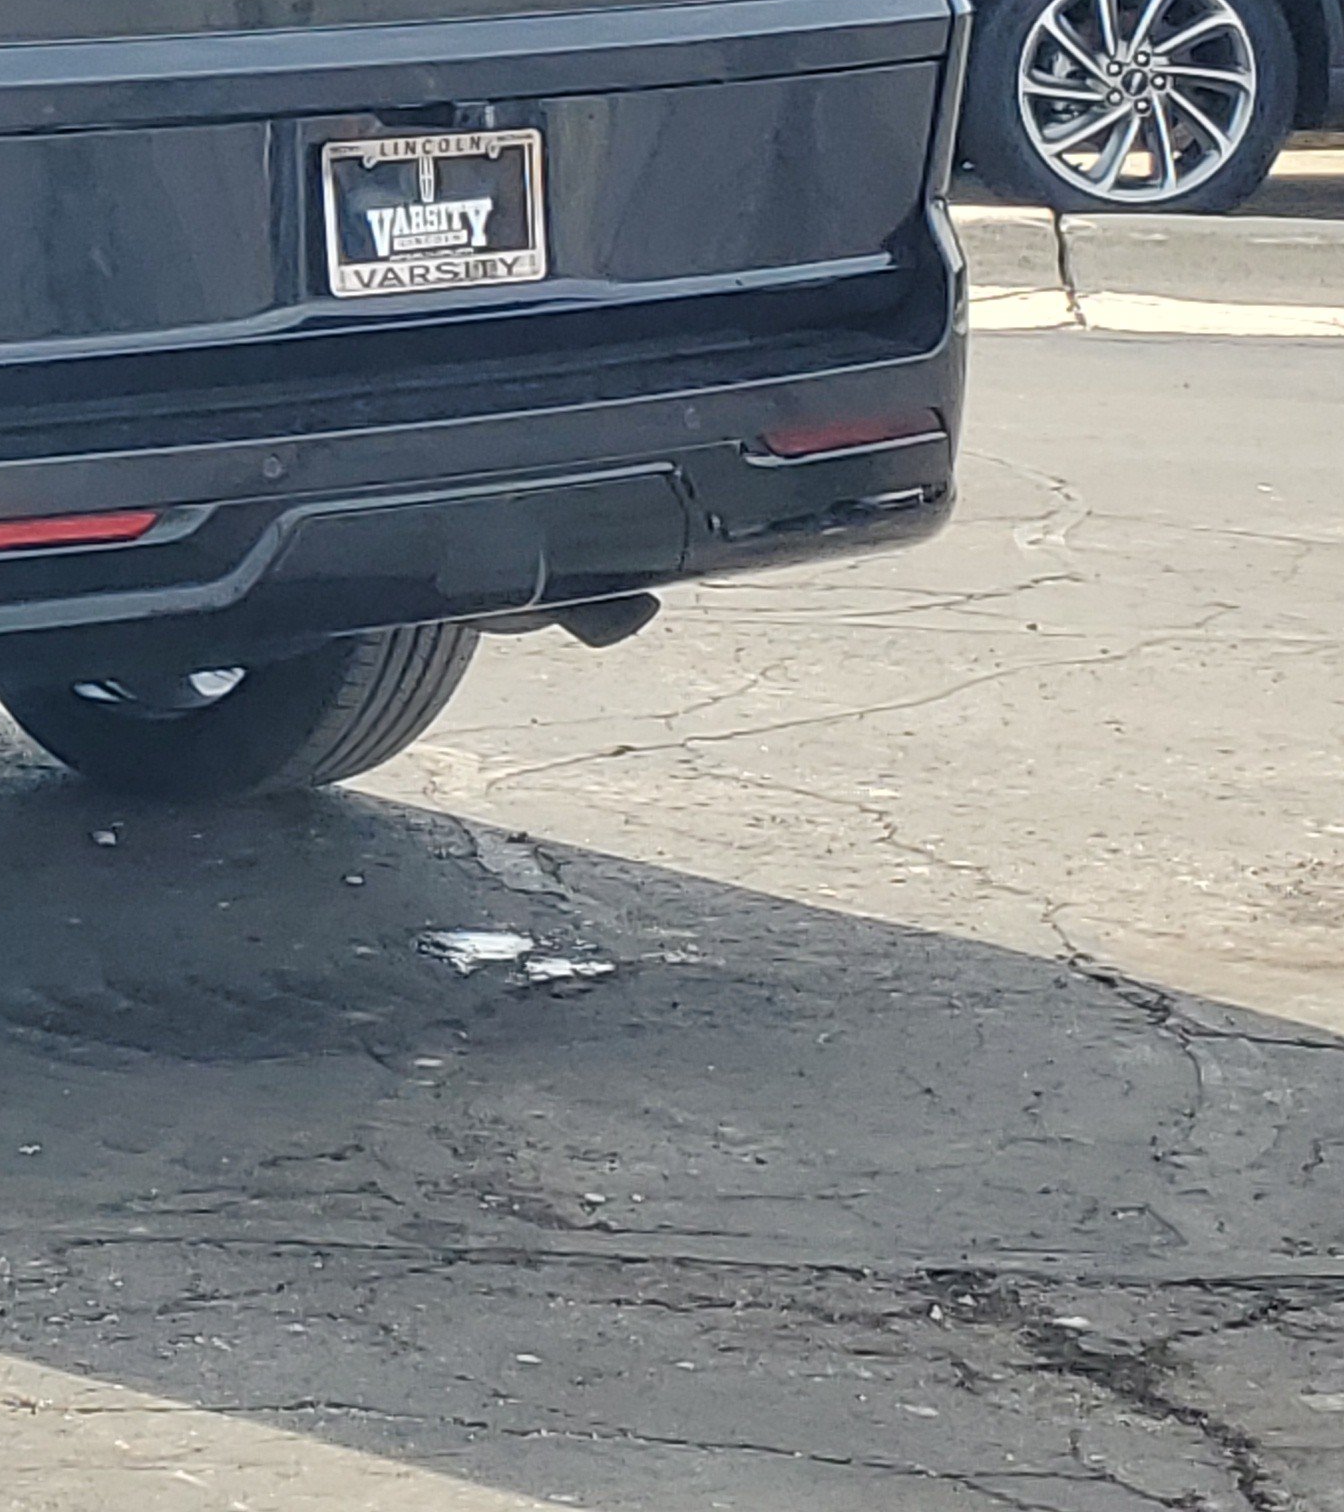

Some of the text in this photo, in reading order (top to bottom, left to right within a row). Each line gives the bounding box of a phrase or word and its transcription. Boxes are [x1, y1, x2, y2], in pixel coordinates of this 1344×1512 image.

[379, 136, 481, 156] LINCOLN
[366, 197, 492, 257] VARSITY
[354, 258, 521, 288] VARSITY
